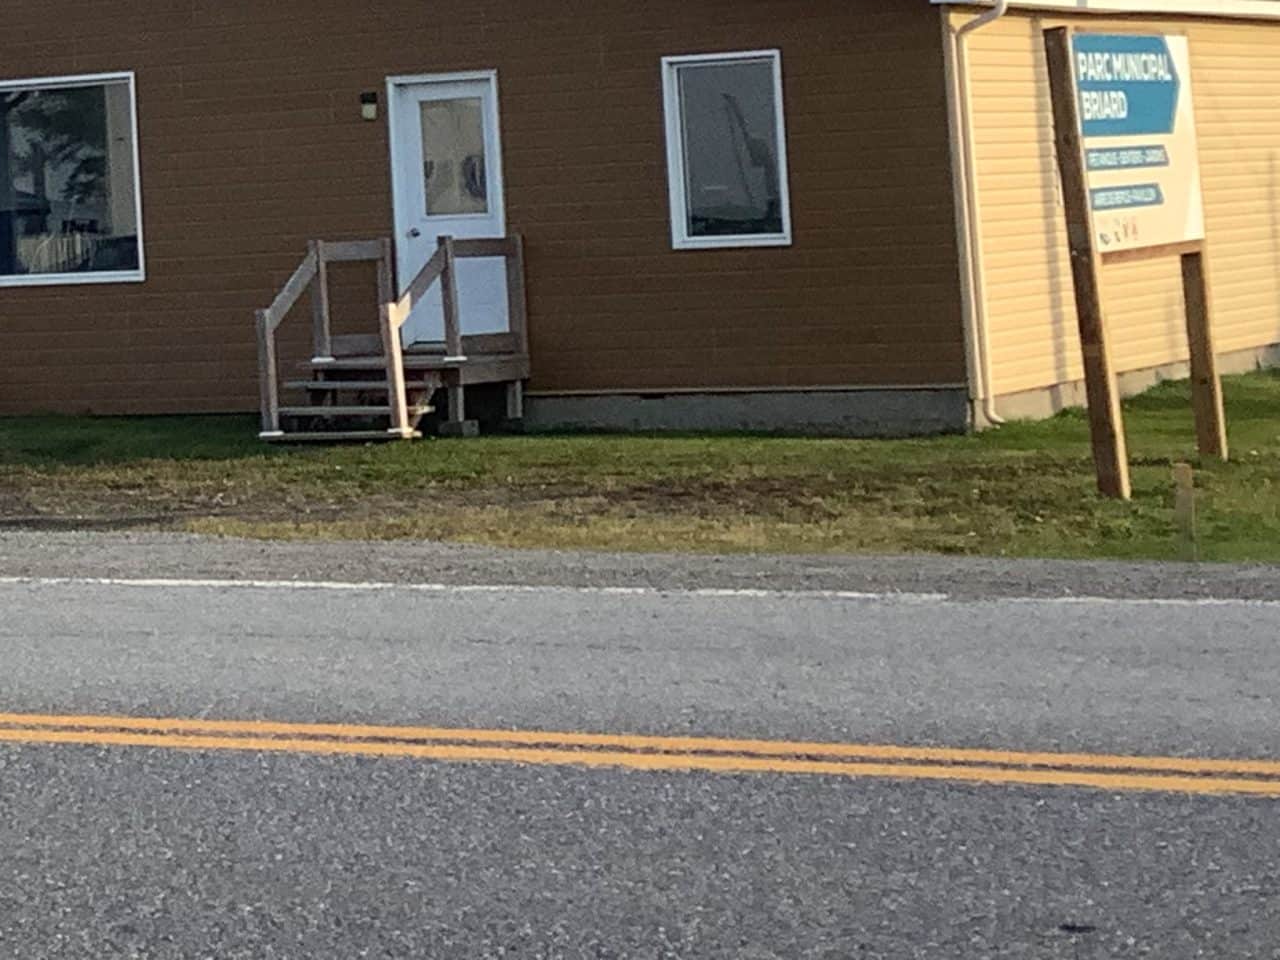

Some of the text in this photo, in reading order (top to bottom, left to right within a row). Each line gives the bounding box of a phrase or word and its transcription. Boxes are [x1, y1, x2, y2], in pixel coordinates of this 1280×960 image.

[1077, 52, 1172, 81] PARC MUNICIPAL
[1081, 90, 1128, 120] BRIARD
